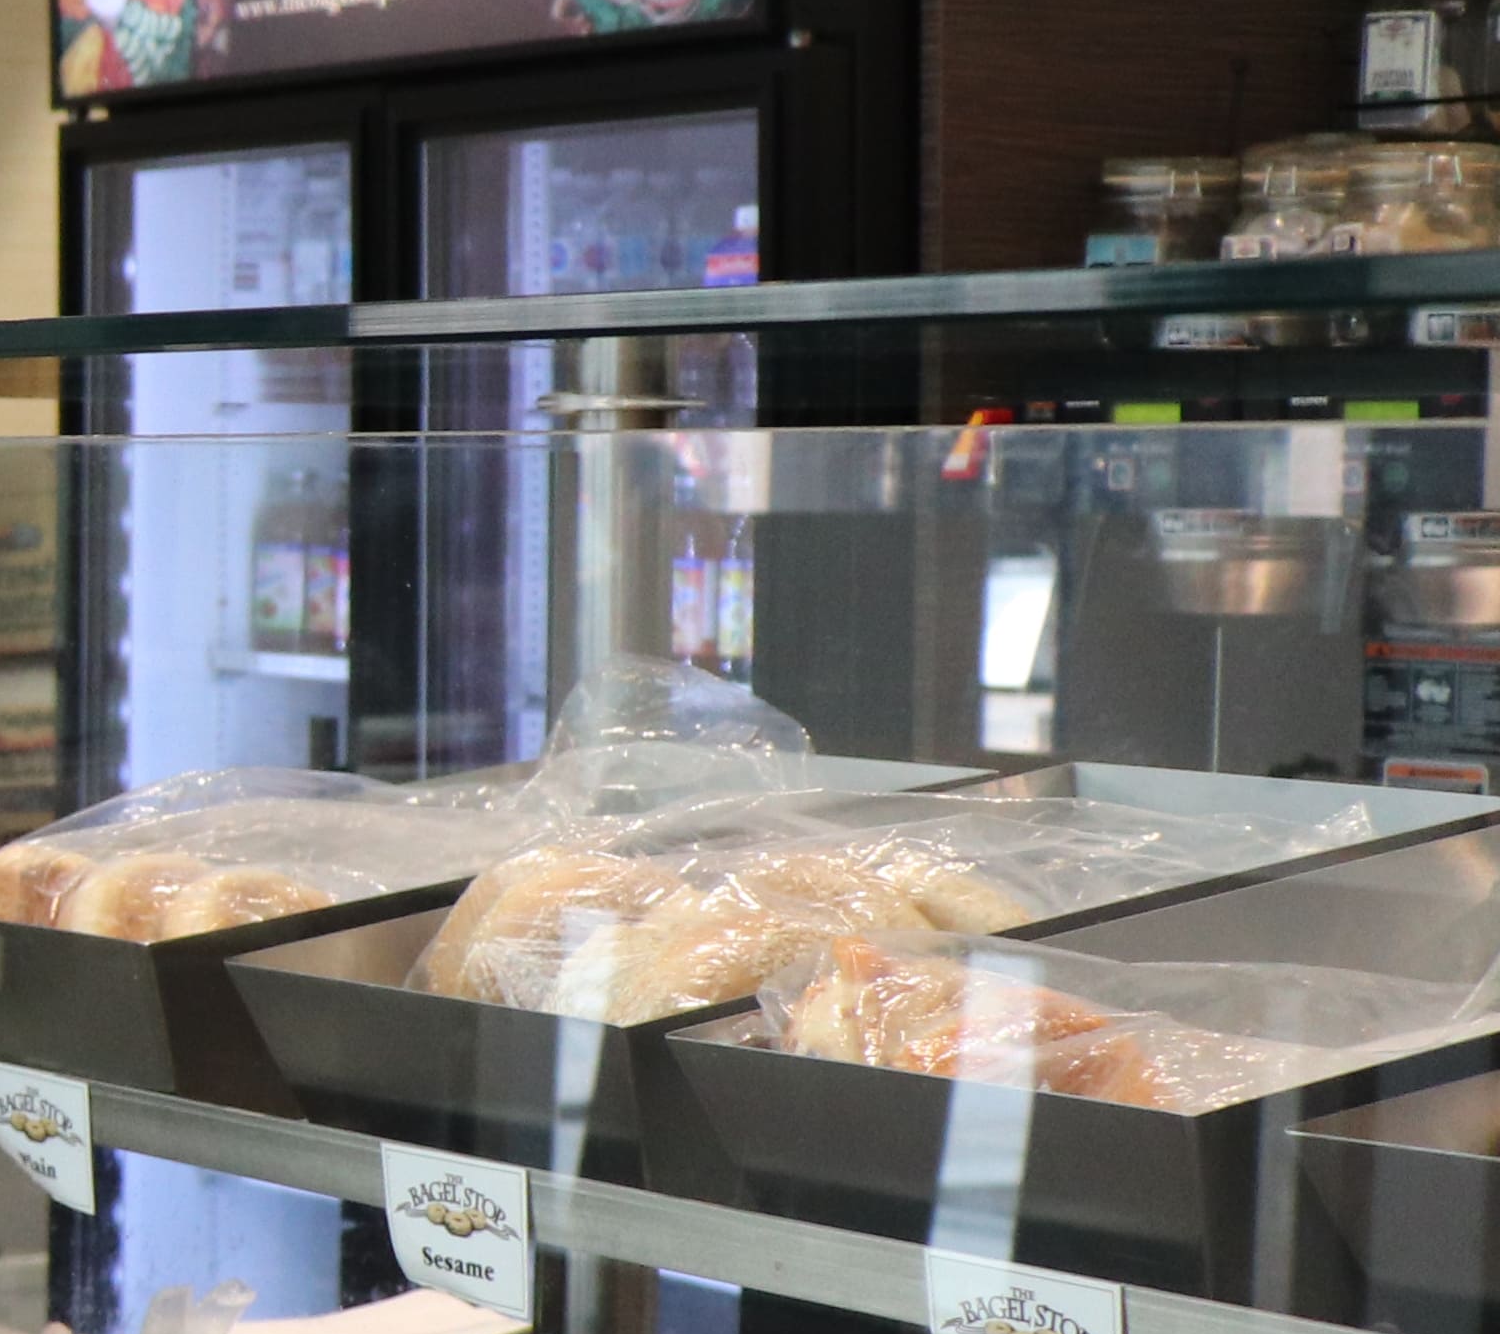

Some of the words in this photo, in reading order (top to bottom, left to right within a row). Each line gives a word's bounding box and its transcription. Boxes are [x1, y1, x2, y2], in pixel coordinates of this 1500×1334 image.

[408, 1180, 461, 1208] BAGEL
[463, 1187, 507, 1224] STOP
[421, 1245, 495, 1282] Sesame
[959, 1294, 1031, 1325] BAGEL
[1010, 1286, 1035, 1302] THE
